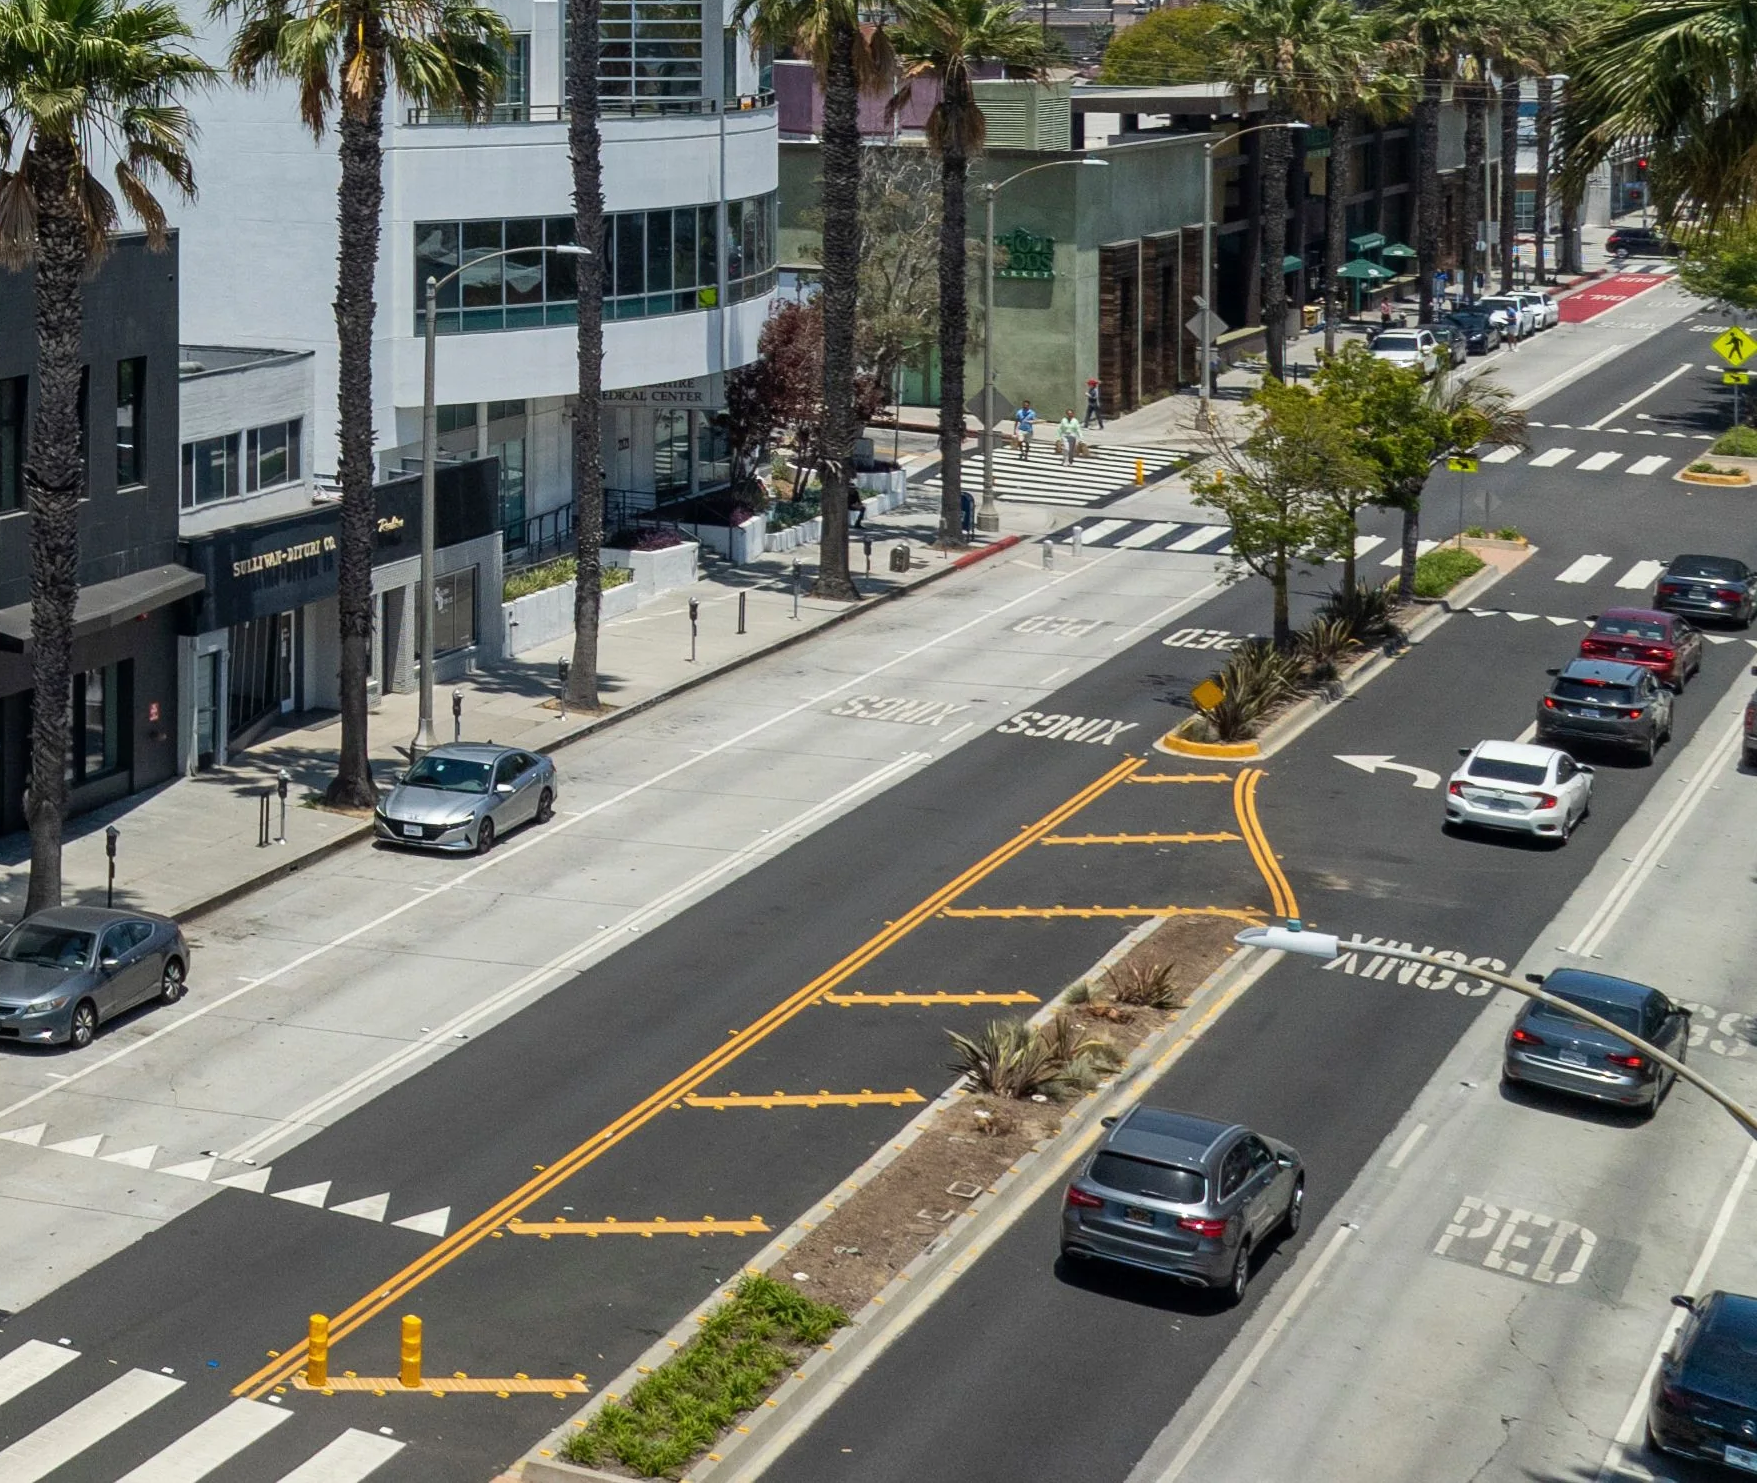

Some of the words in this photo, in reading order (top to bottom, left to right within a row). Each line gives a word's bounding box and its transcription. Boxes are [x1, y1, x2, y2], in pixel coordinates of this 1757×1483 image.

[602, 390, 647, 401] EDICAL
[651, 391, 703, 401] CENTER
[830, 694, 971, 727] XINGS
[995, 711, 1140, 746] XINGS
[1322, 933, 1507, 997] XINGS
[1434, 1195, 1598, 1285] PED
